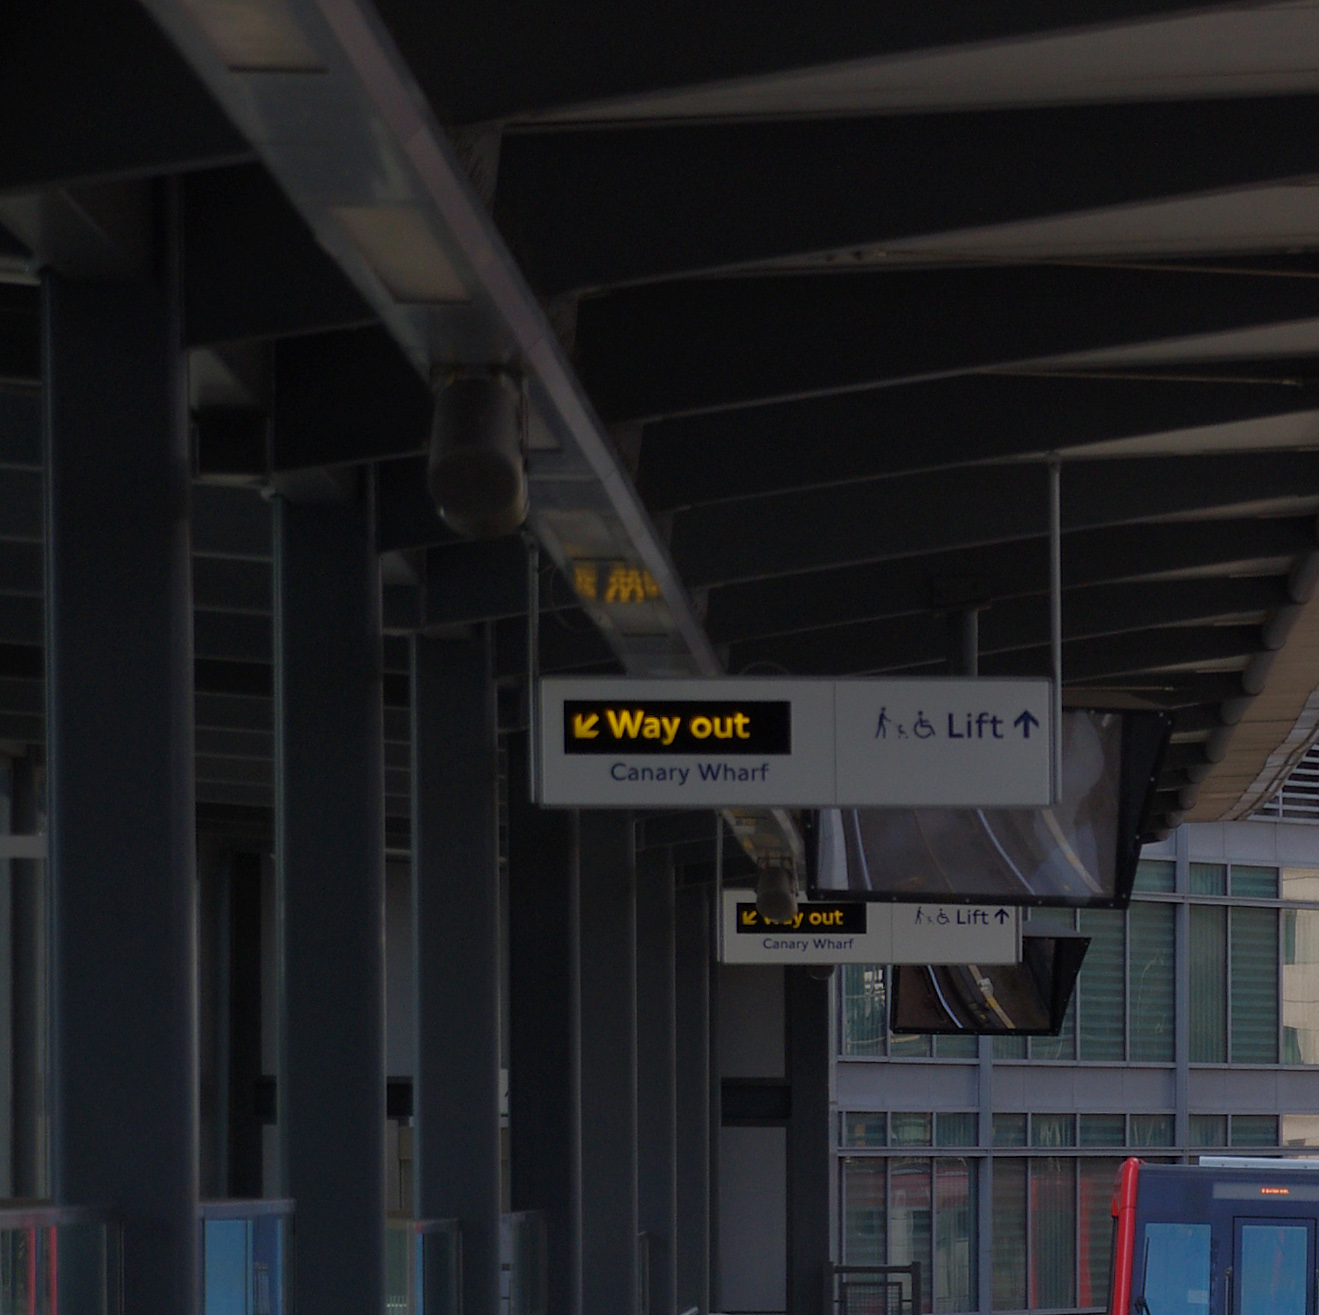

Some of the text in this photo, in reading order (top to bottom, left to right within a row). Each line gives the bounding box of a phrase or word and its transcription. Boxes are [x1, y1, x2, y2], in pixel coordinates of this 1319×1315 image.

[607, 710, 751, 746] Way out
[947, 712, 1004, 739] Lift
[611, 762, 769, 786] Canary Wharf
[957, 909, 989, 925] Lift
[763, 937, 854, 951] Canary Wharf
